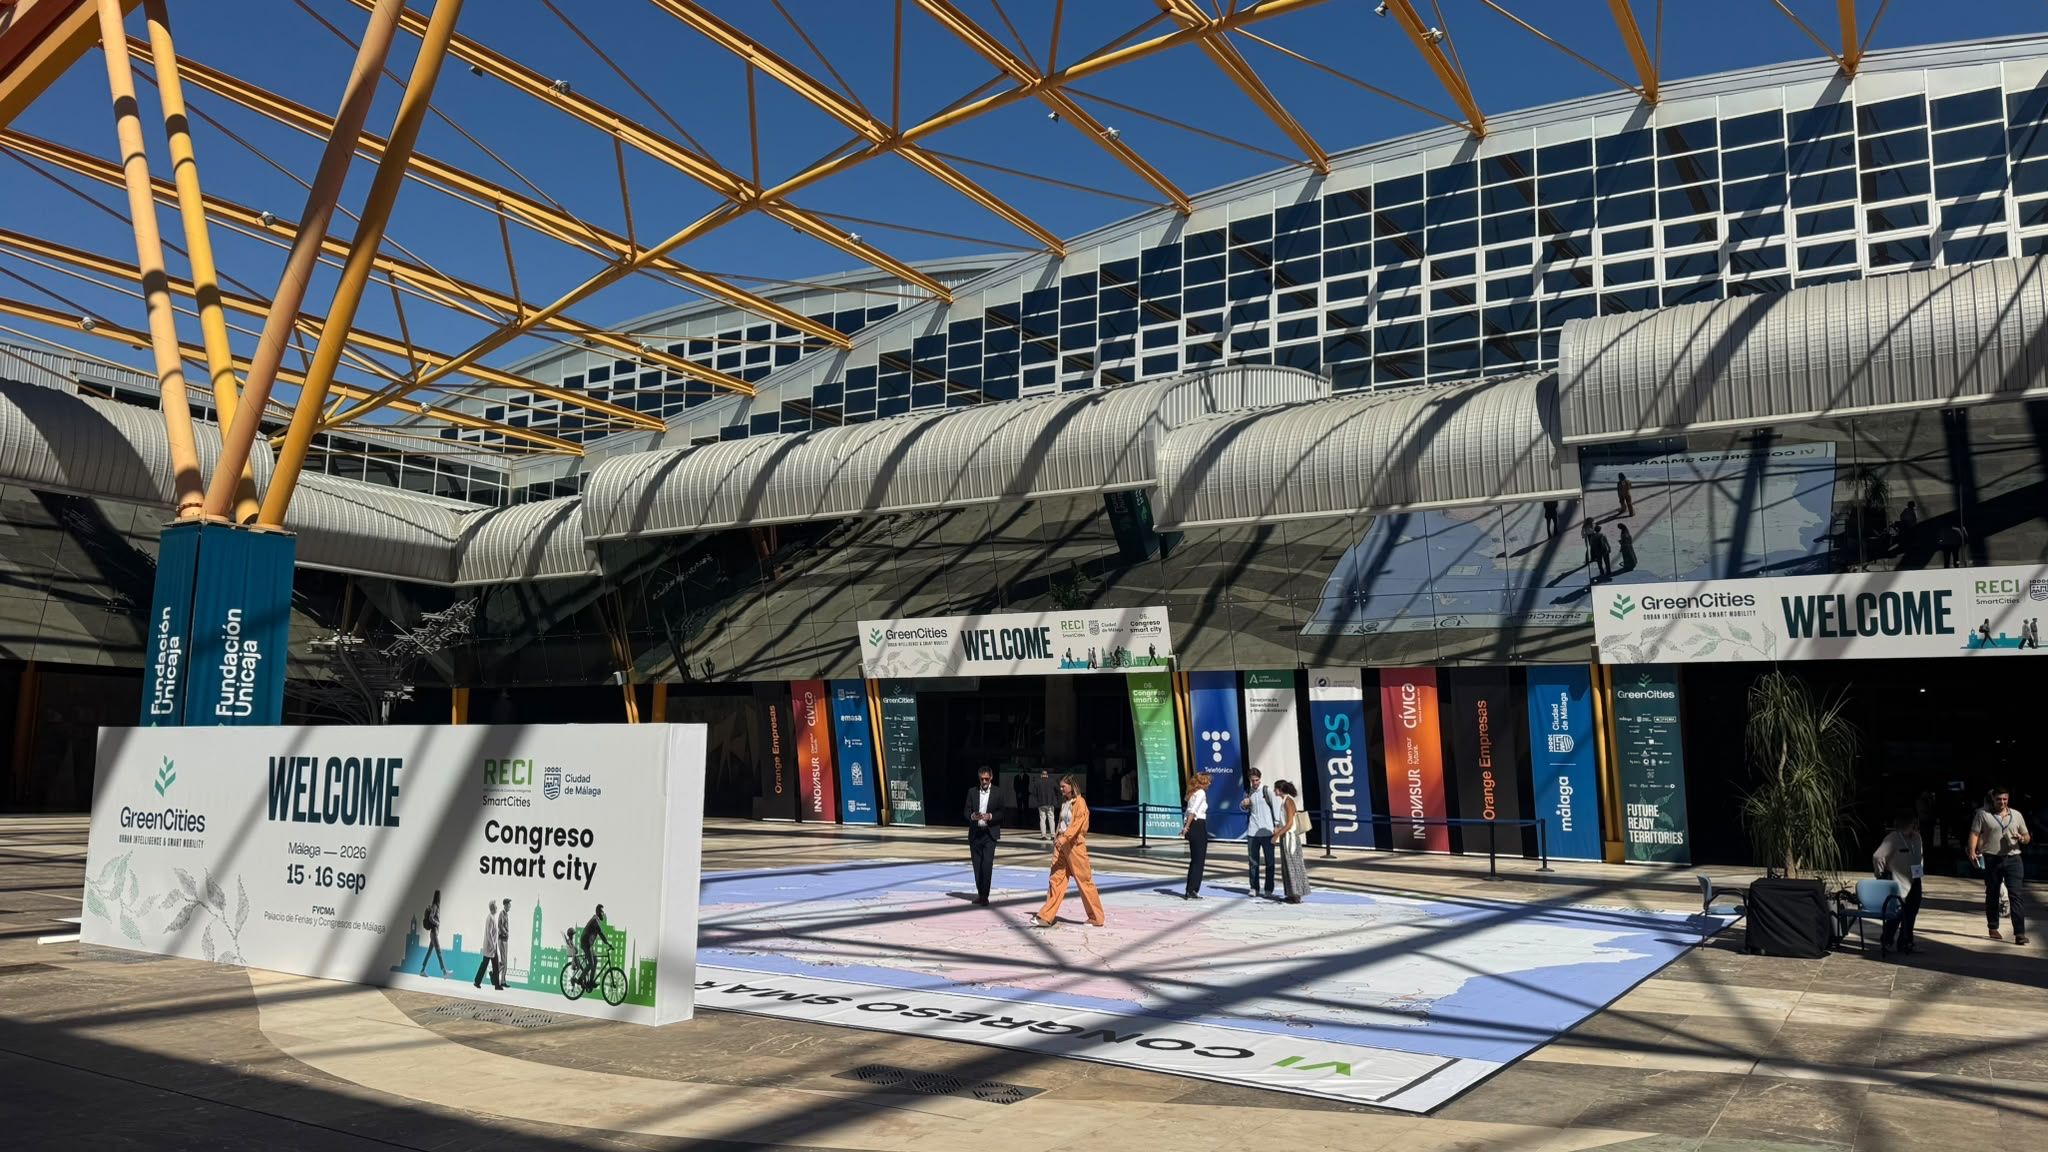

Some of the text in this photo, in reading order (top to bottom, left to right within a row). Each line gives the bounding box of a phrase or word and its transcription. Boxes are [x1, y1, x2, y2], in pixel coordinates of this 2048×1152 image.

[1975, 579, 2020, 594] RECI
[1641, 592, 1756, 610] GreenCities
[1781, 589, 1955, 639] WELCOME
[1975, 597, 2020, 605] SmartCities
[1060, 620, 1085, 631] RECI
[1130, 620, 1161, 628] Congreso
[1662, 612, 1700, 620] INTELLIGENCE
[885, 627, 948, 640] GreenCities
[1150, 626, 1162, 634] city
[960, 626, 1054, 662] WELCOME
[151, 607, 172, 715] Fundación
[215, 608, 243, 716] Fundación
[161, 636, 182, 715] Unicaja
[234, 640, 262, 717] Unicaja
[1132, 689, 1166, 698] Congreso
[1617, 690, 1675, 699] GreenCities
[1551, 703, 1560, 731] Ciudad
[1560, 692, 1569, 731] de Málaga
[769, 705, 783, 794] Orange Empresas
[1477, 699, 1496, 821] Orange Empresas
[483, 759, 533, 785] RECI
[564, 774, 591, 784] Ciudad
[812, 757, 822, 813] INNOVASUR
[1324, 713, 1359, 834] uma.es
[267, 755, 403, 828] WELCOME
[482, 795, 531, 807] SmartCities
[564, 786, 602, 798] de Málaga
[1406, 768, 1426, 840] INNOVASUR
[1555, 776, 1574, 832] málaga
[892, 800, 922, 811] TERRITORIES
[1626, 803, 1660, 817] FUTURE
[120, 806, 206, 833] GreenCities
[1627, 816, 1655, 830] READY
[484, 819, 594, 854] Congreso
[1628, 830, 1684, 845] TERRITORIES
[288, 842, 321, 858] Málaga
[340, 845, 367, 860] 2026
[287, 863, 304, 885] 15
[315, 865, 333, 887] 16
[337, 871, 366, 895] sep
[479, 853, 597, 890] smart city
[264, 911, 285, 922] Palacio
[286, 913, 294, 922] de
[295, 914, 313, 925] Ferias
[319, 917, 352, 929] Congresos
[353, 920, 361, 930] de
[362, 922, 386, 935] Málaga
[312, 905, 336, 916] FYCMA
[695, 980, 1352, 1077] VI CONGRESO SMAR
